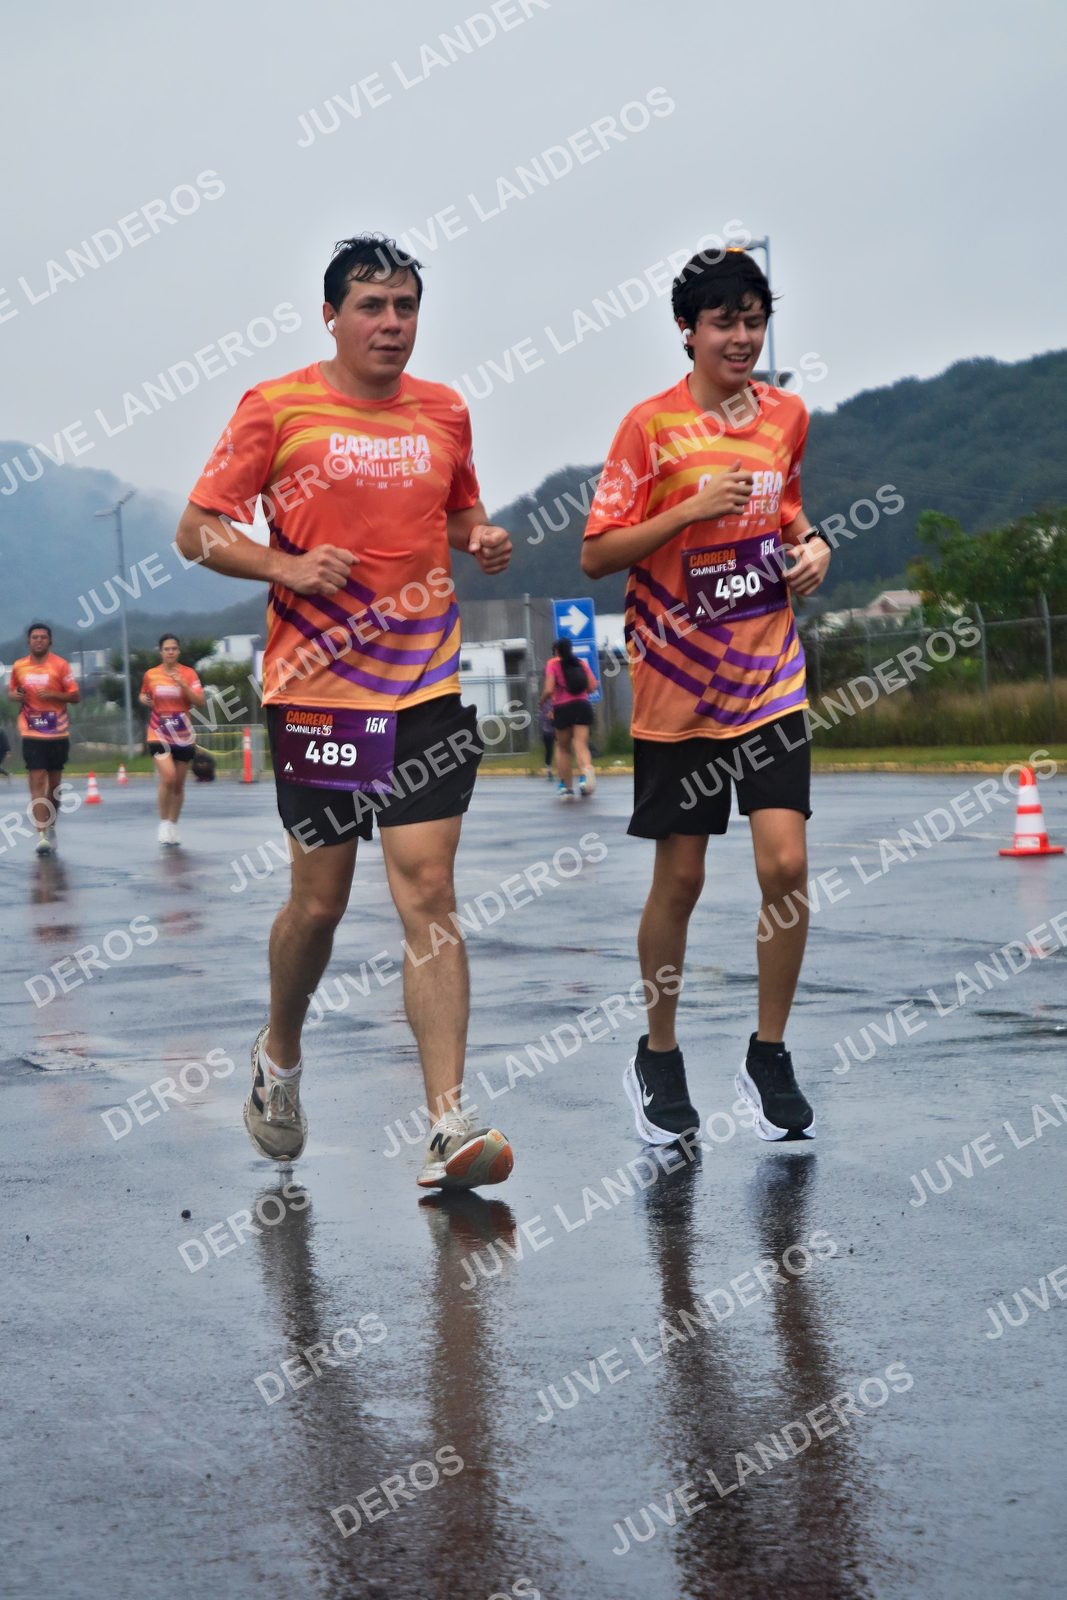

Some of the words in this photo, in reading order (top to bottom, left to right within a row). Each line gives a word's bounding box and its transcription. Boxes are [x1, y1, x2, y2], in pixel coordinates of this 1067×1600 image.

[329, 432, 430, 460] CARRERA
[331, 456, 411, 478] OMNILIFE
[742, 499, 767, 515] LIFE
[689, 548, 737, 568] CARRERA
[690, 562, 727, 577] OMNILIFE
[715, 571, 761, 600] 490
[285, 723, 322, 736] OMNILIFE
[286, 710, 334, 726] CARRERA
[365, 716, 389, 735] 15K
[305, 740, 357, 768] 489
